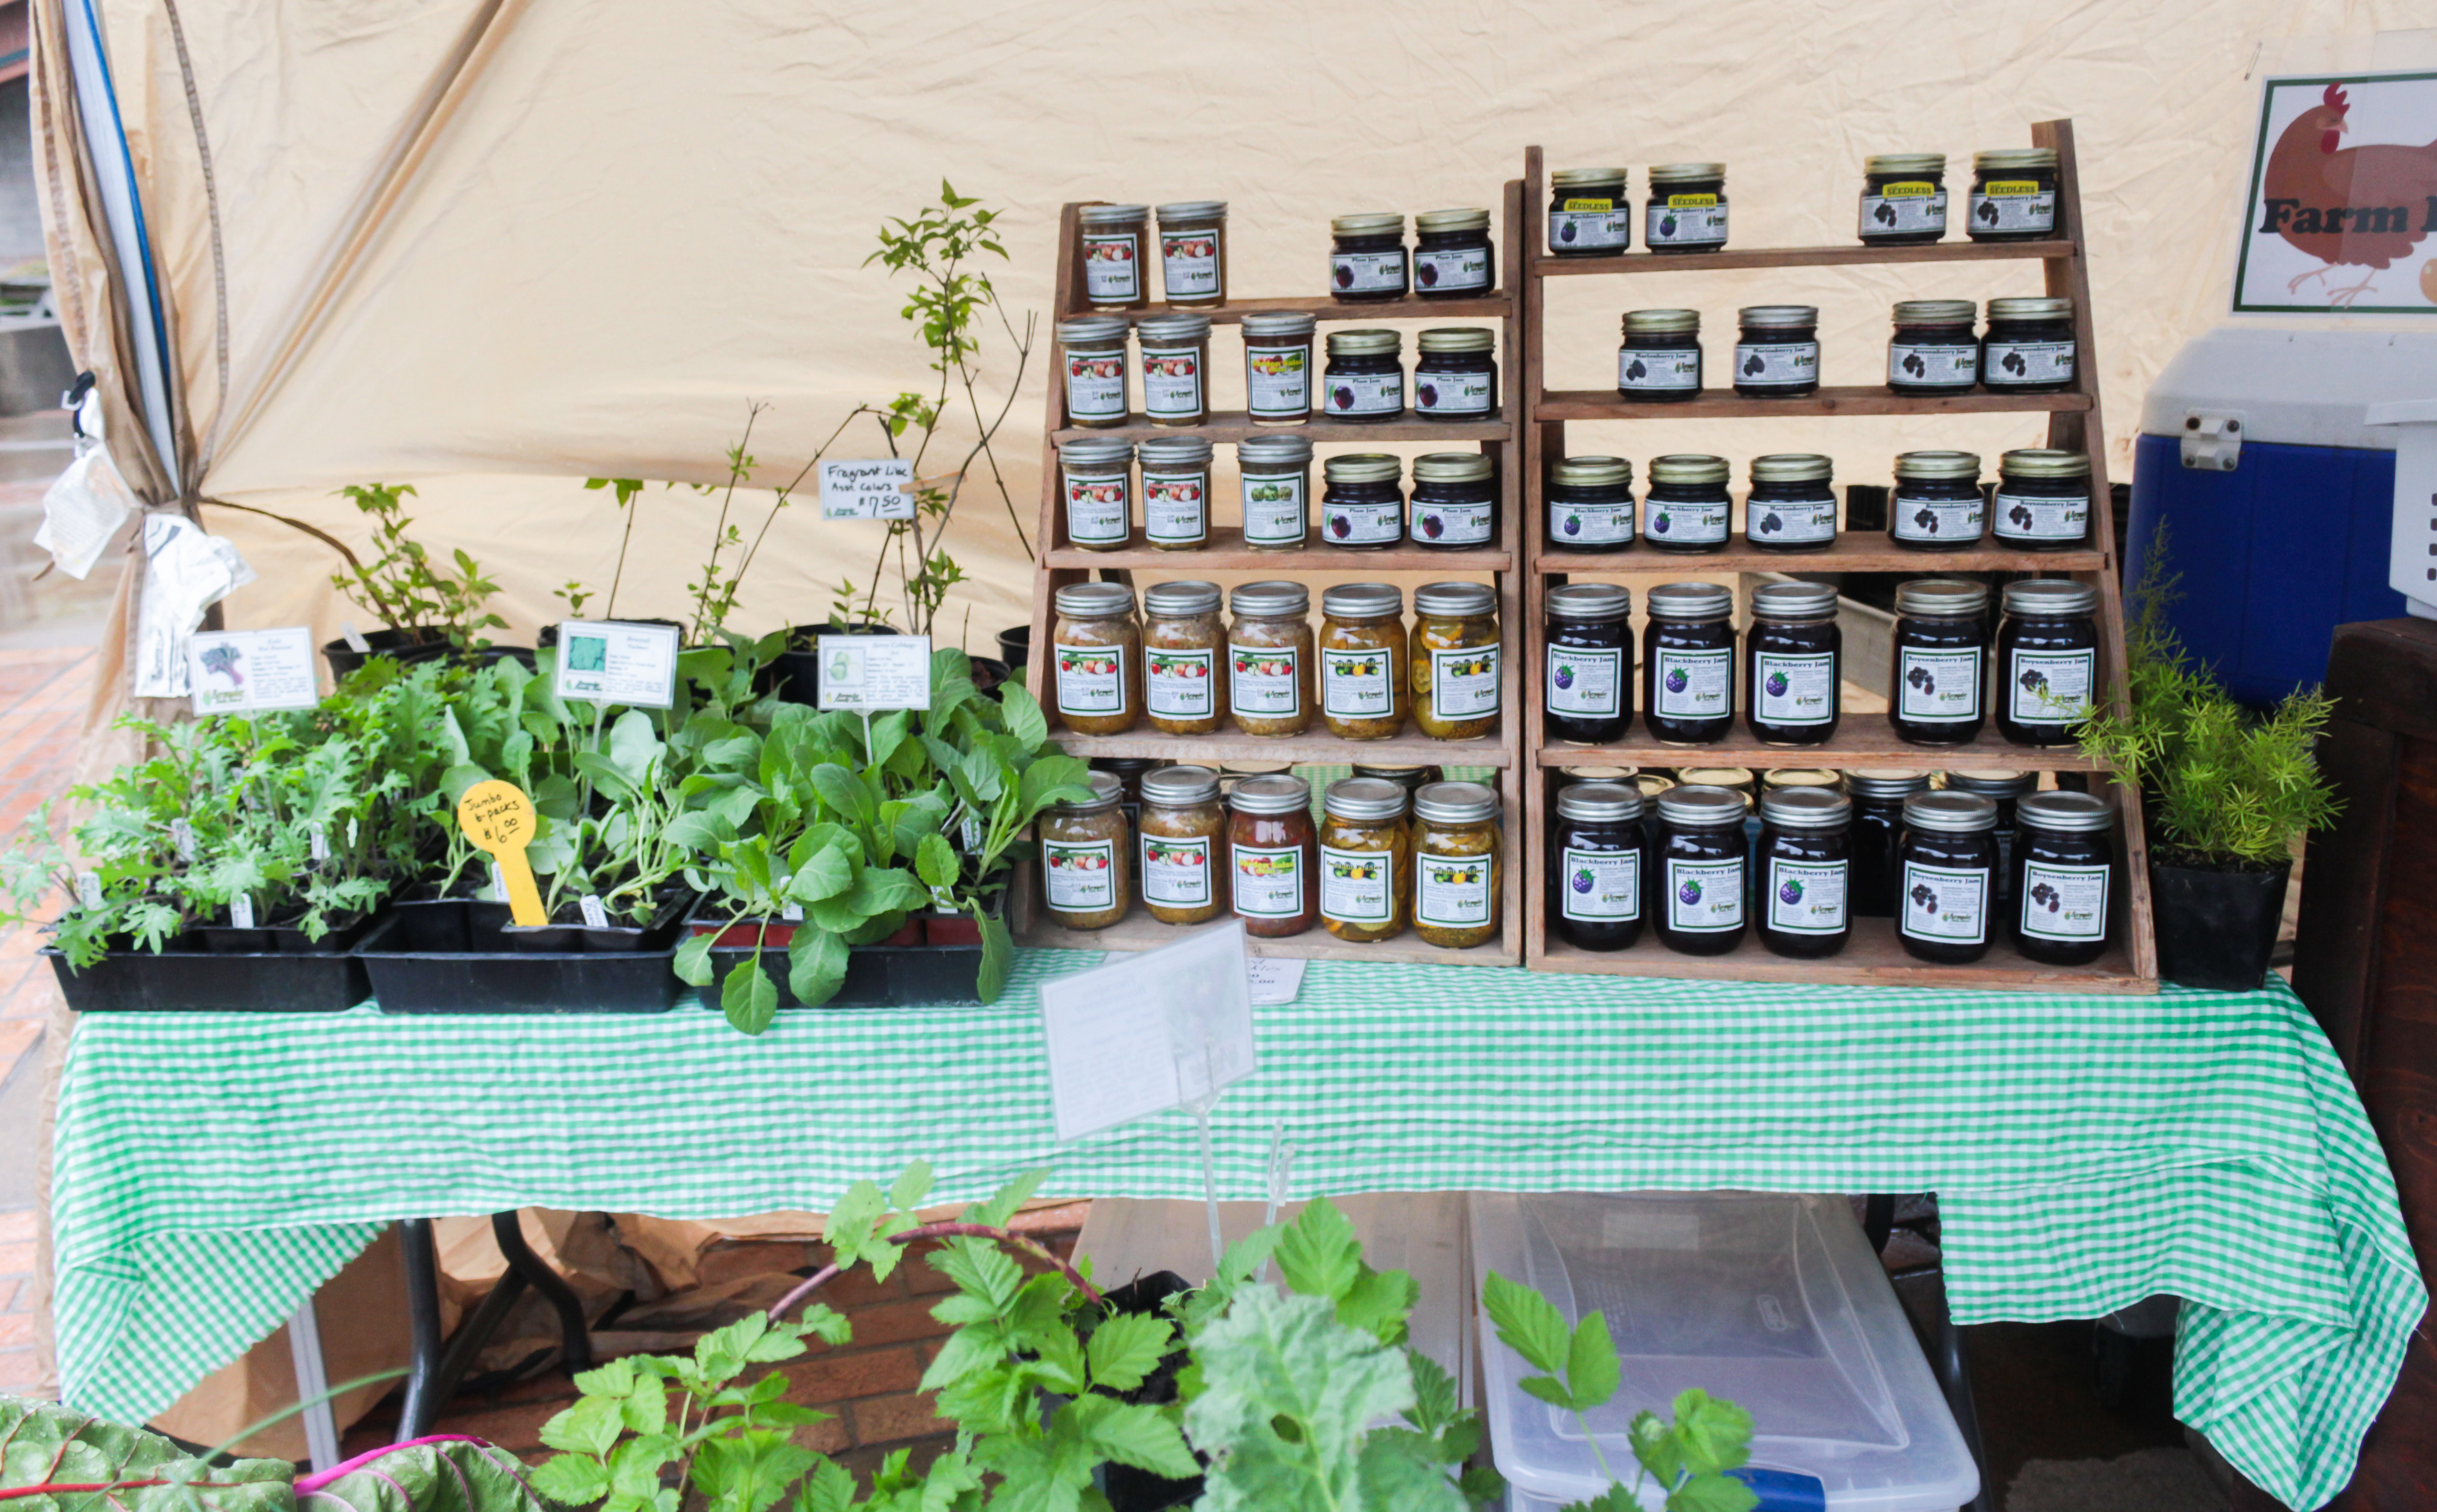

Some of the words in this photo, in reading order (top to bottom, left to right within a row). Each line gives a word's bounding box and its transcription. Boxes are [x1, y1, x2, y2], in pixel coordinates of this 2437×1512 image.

[2259, 198, 2408, 234] Farm
[860, 483, 892, 491] Colors
[1553, 653, 1597, 663] Blackberry
[465, 793, 502, 810] Jumbo
[1571, 857, 1618, 865] Blackberry
[1728, 866, 1741, 875] Jam
[1779, 867, 1828, 877] Blackberry
[2032, 870, 2086, 881] Boysenberry
[1911, 872, 1962, 884] Boysenberry
